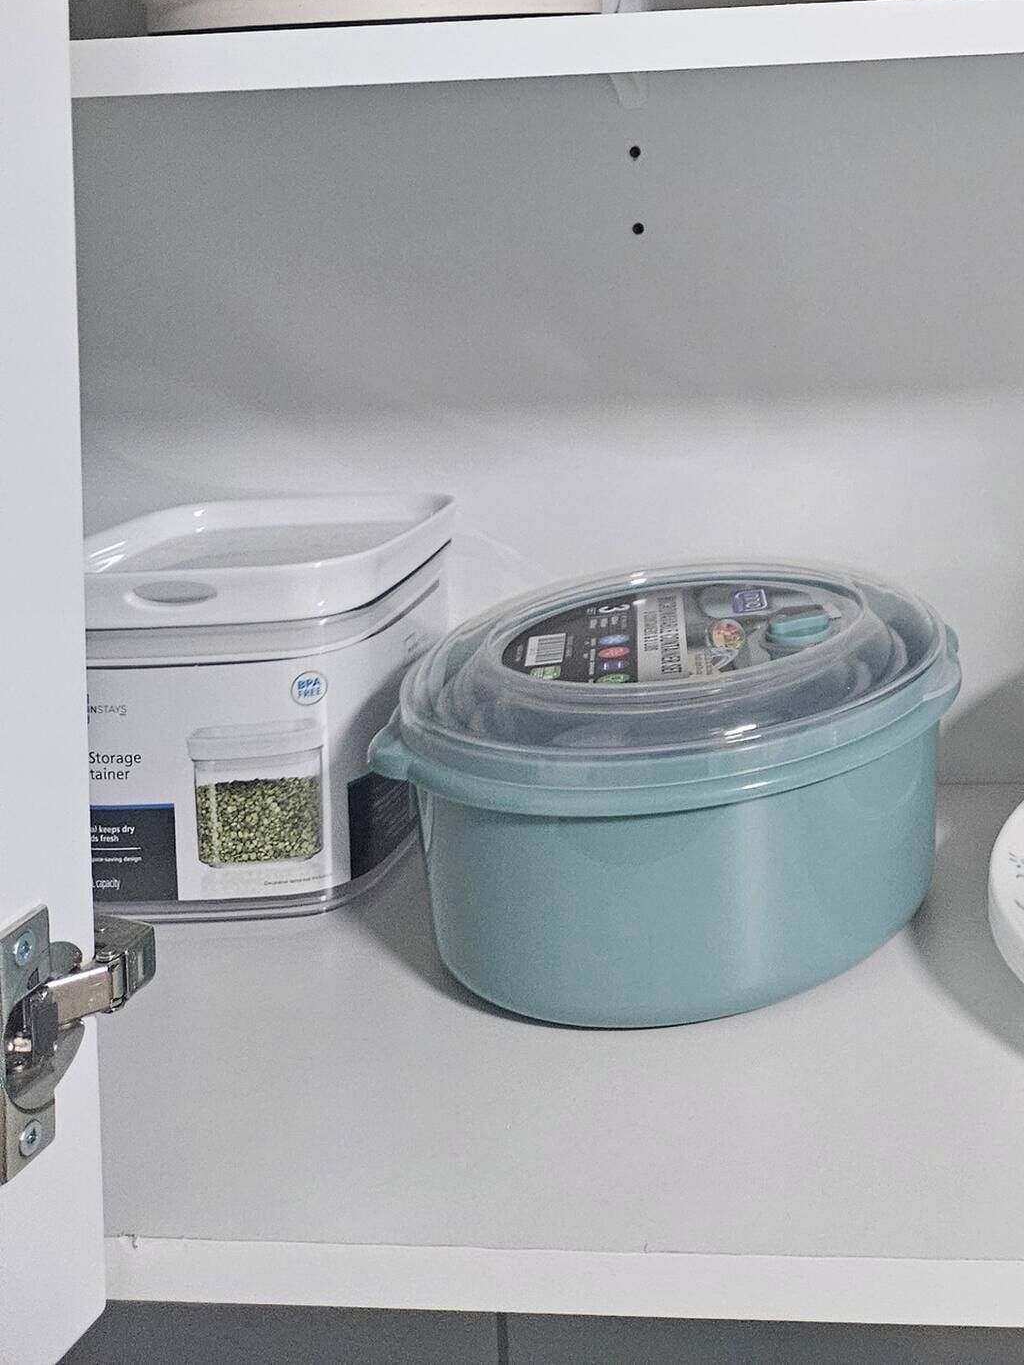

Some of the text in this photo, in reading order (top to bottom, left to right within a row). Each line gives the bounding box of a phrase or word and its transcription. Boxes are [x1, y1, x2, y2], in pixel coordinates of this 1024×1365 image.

[297, 678, 320, 690] BPA
[88, 751, 142, 767] Storage
[89, 767, 130, 780] tainer
[99, 825, 120, 834] keeps
[121, 825, 135, 834] dry
[100, 834, 119, 842] fresh
